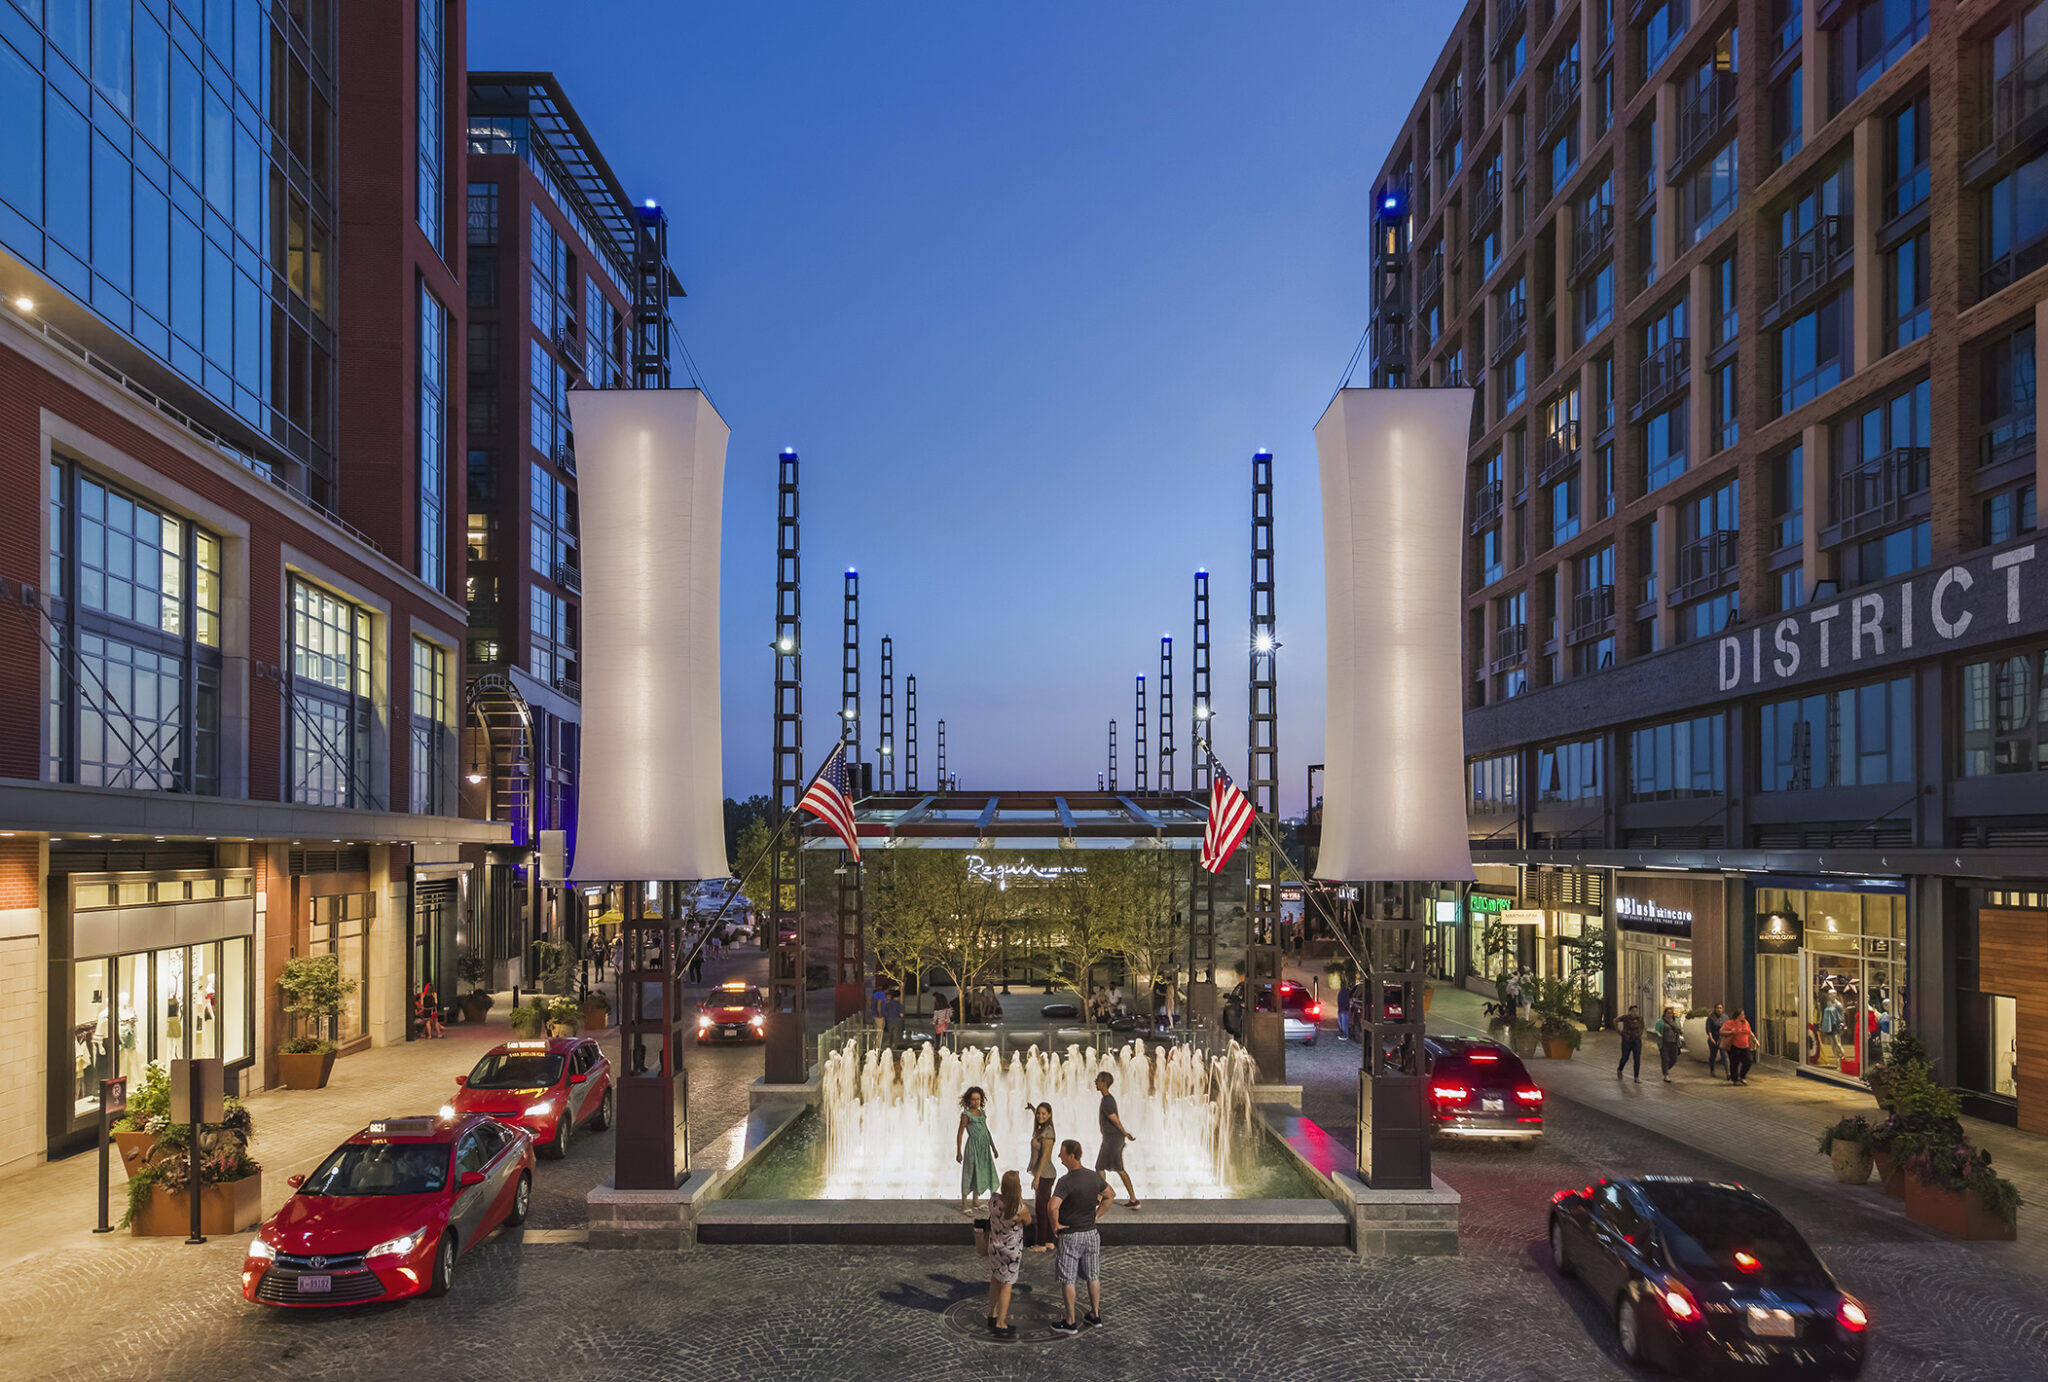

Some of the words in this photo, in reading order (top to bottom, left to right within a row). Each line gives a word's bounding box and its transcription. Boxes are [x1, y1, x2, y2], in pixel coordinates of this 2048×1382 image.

[1719, 544, 2036, 693] DISTRICT
[1624, 897, 1656, 918] Blush
[1656, 907, 1693, 922] skincare
